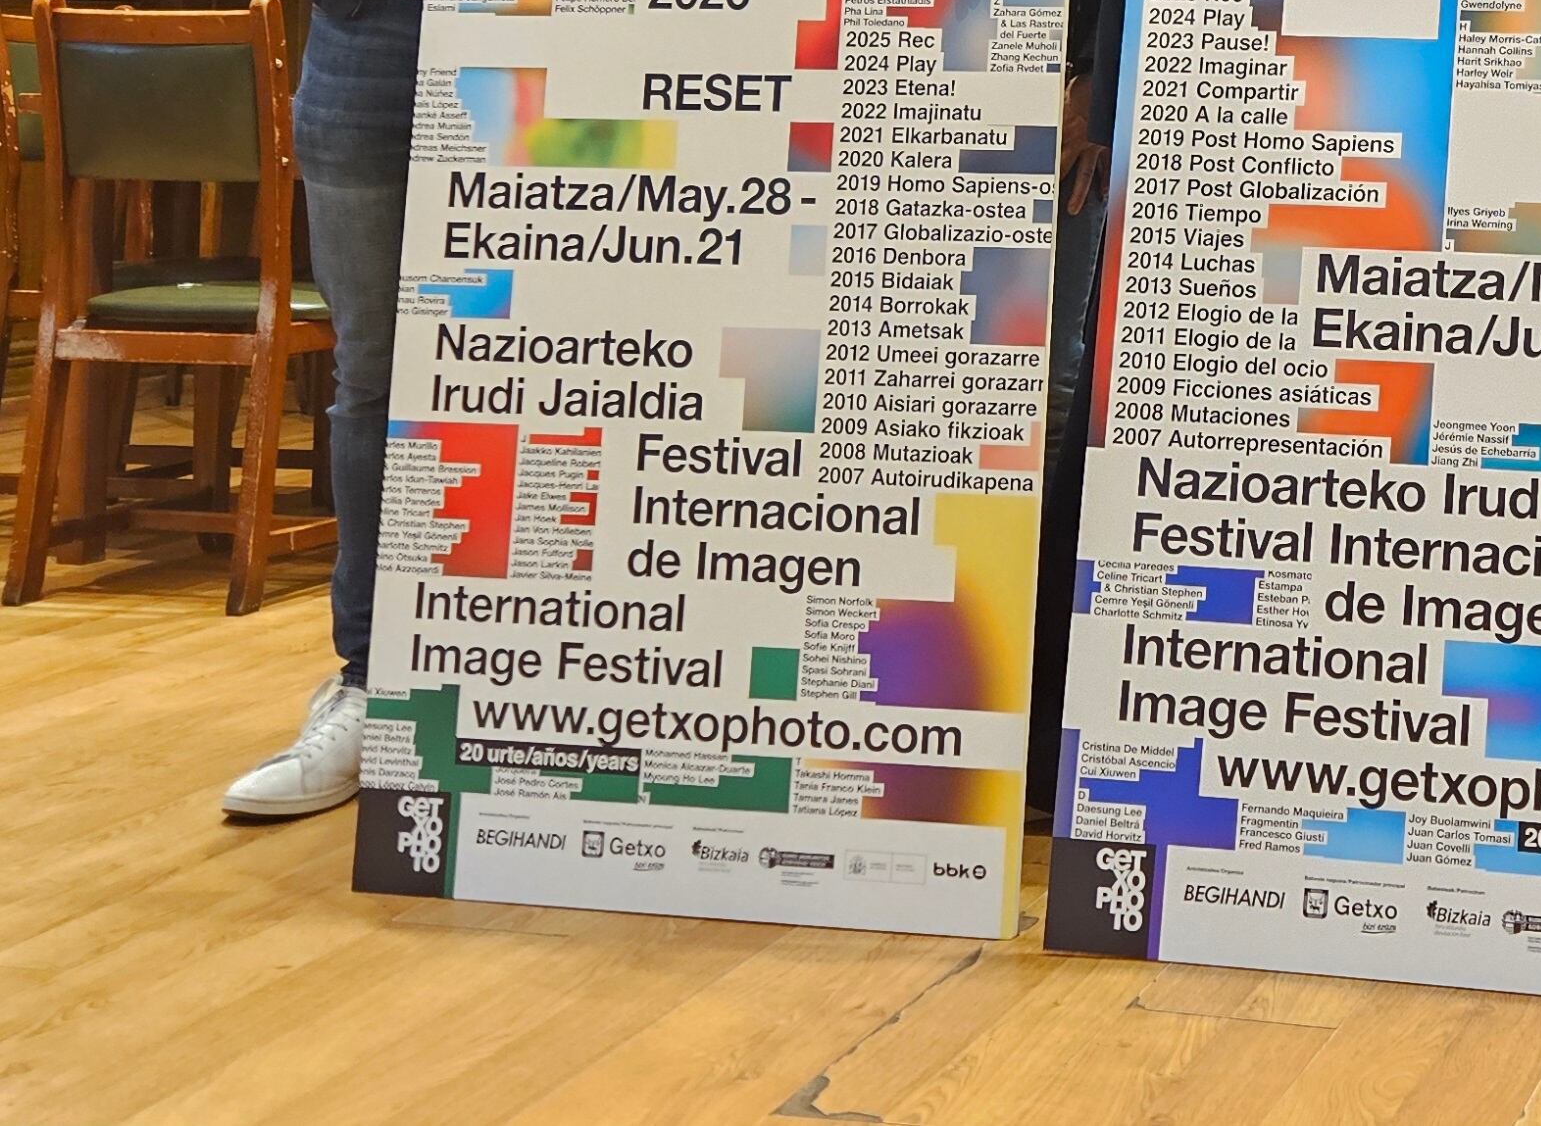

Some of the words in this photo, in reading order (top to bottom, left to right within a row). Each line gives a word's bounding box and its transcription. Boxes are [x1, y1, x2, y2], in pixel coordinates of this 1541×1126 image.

[992, 7, 1027, 16] Zahara
[1148, 7, 1194, 24] 2024
[1203, 8, 1244, 30] Play
[845, 30, 890, 47] 2025
[898, 31, 934, 48] Rec
[1146, 31, 1193, 49] 2023
[1201, 32, 1268, 51] Pause!
[1457, 44, 1496, 54] Hannah
[1498, 45, 1533, 55] Collins
[1144, 55, 1191, 73] 2022
[1199, 56, 1287, 79] Imaginar
[642, 73, 792, 111] RESET
[842, 78, 887, 95] 2023
[895, 78, 955, 96] Etena!
[1140, 104, 1187, 122] 2020
[1194, 105, 1209, 122] A
[1217, 105, 1233, 123] la
[1240, 107, 1287, 124] calle
[839, 126, 881, 143] 2021
[892, 127, 1007, 145] Elkarbanatu
[1136, 152, 1181, 170] 2018
[1189, 154, 1234, 172] Post
[1241, 155, 1333, 175] Conflicto
[448, 171, 790, 222] Maiatza/May.28
[835, 198, 878, 215] 2018
[886, 198, 1025, 218] Gatazka-ostea
[1132, 201, 1177, 220] 2016
[1185, 203, 1261, 226] Tiempo
[444, 221, 741, 264] Ekaina/Jun.21
[831, 246, 875, 263] 2016
[883, 247, 965, 266] Denbora
[1125, 275, 1171, 294] 2013
[1179, 277, 1256, 298] Sueños
[829, 294, 872, 312] 2014
[880, 295, 968, 314] Borrokak
[435, 323, 692, 367] Nazioarteko
[826, 343, 869, 361] 2012
[877, 344, 938, 363] Umeei
[944, 351, 1039, 368] gorazarre
[1119, 351, 1165, 369] 2010
[1173, 353, 1237, 376] Elogio
[1245, 356, 1275, 374] del
[1283, 359, 1327, 377] ocio
[431, 374, 524, 414] Irudi
[538, 378, 702, 420] Jaialdia
[1116, 376, 1165, 395] 2009
[1173, 378, 1271, 400] Ficciones
[1279, 384, 1370, 405] asiáticas
[821, 417, 867, 435] 2009
[874, 418, 940, 437] Asiako
[947, 420, 1023, 440] fikzioak
[1112, 426, 1161, 446] 2007
[1167, 429, 1382, 458] Autorrepresentación
[637, 433, 801, 476] Festival
[817, 466, 864, 484] 2007
[870, 468, 1032, 494] Autoirudikapena
[1137, 456, 1425, 512] Nazioarteko
[633, 485, 920, 535] Internacional
[1132, 511, 1312, 562] Festival
[627, 538, 680, 578] de
[696, 541, 860, 593] Imagen
[415, 581, 685, 631] International
[805, 594, 837, 604] Simon
[1325, 580, 1384, 623] de
[411, 633, 541, 686] Image
[557, 641, 722, 687] Festival
[1123, 623, 1427, 684] International
[1119, 679, 1267, 738] Image
[1284, 691, 1470, 746] Festival
[473, 700, 961, 756] www.getxophoto.com
[459, 742, 483, 761] 20
[487, 745, 638, 773] urte/años/years
[1081, 740, 1121, 753] Cristina
[1123, 743, 1138, 754] De
[1139, 744, 1175, 757] Middel
[1075, 802, 1122, 818] Daesung
[1123, 806, 1143, 817] Lee
[1075, 814, 1108, 826] Daniel
[1241, 802, 1290, 816] Fernando
[1407, 812, 1428, 826] Joy
[1429, 814, 1491, 829] Buolamwini
[1240, 814, 1299, 831] Fragmentin
[1407, 825, 1434, 837] Juan
[1435, 828, 1471, 840] Carlos
[475, 828, 566, 850] BEGIHANDI
[1239, 826, 1293, 840] Francesco
[1294, 830, 1325, 843] Giusti
[609, 836, 665, 857] Getxo
[700, 846, 749, 864] Bizkaia
[1405, 851, 1432, 863] Juan
[933, 863, 970, 880] bbk
[1183, 884, 1285, 908] BEGIHANDI
[1334, 895, 1397, 919] Getxo
[1436, 907, 1490, 926] Bizkaia
